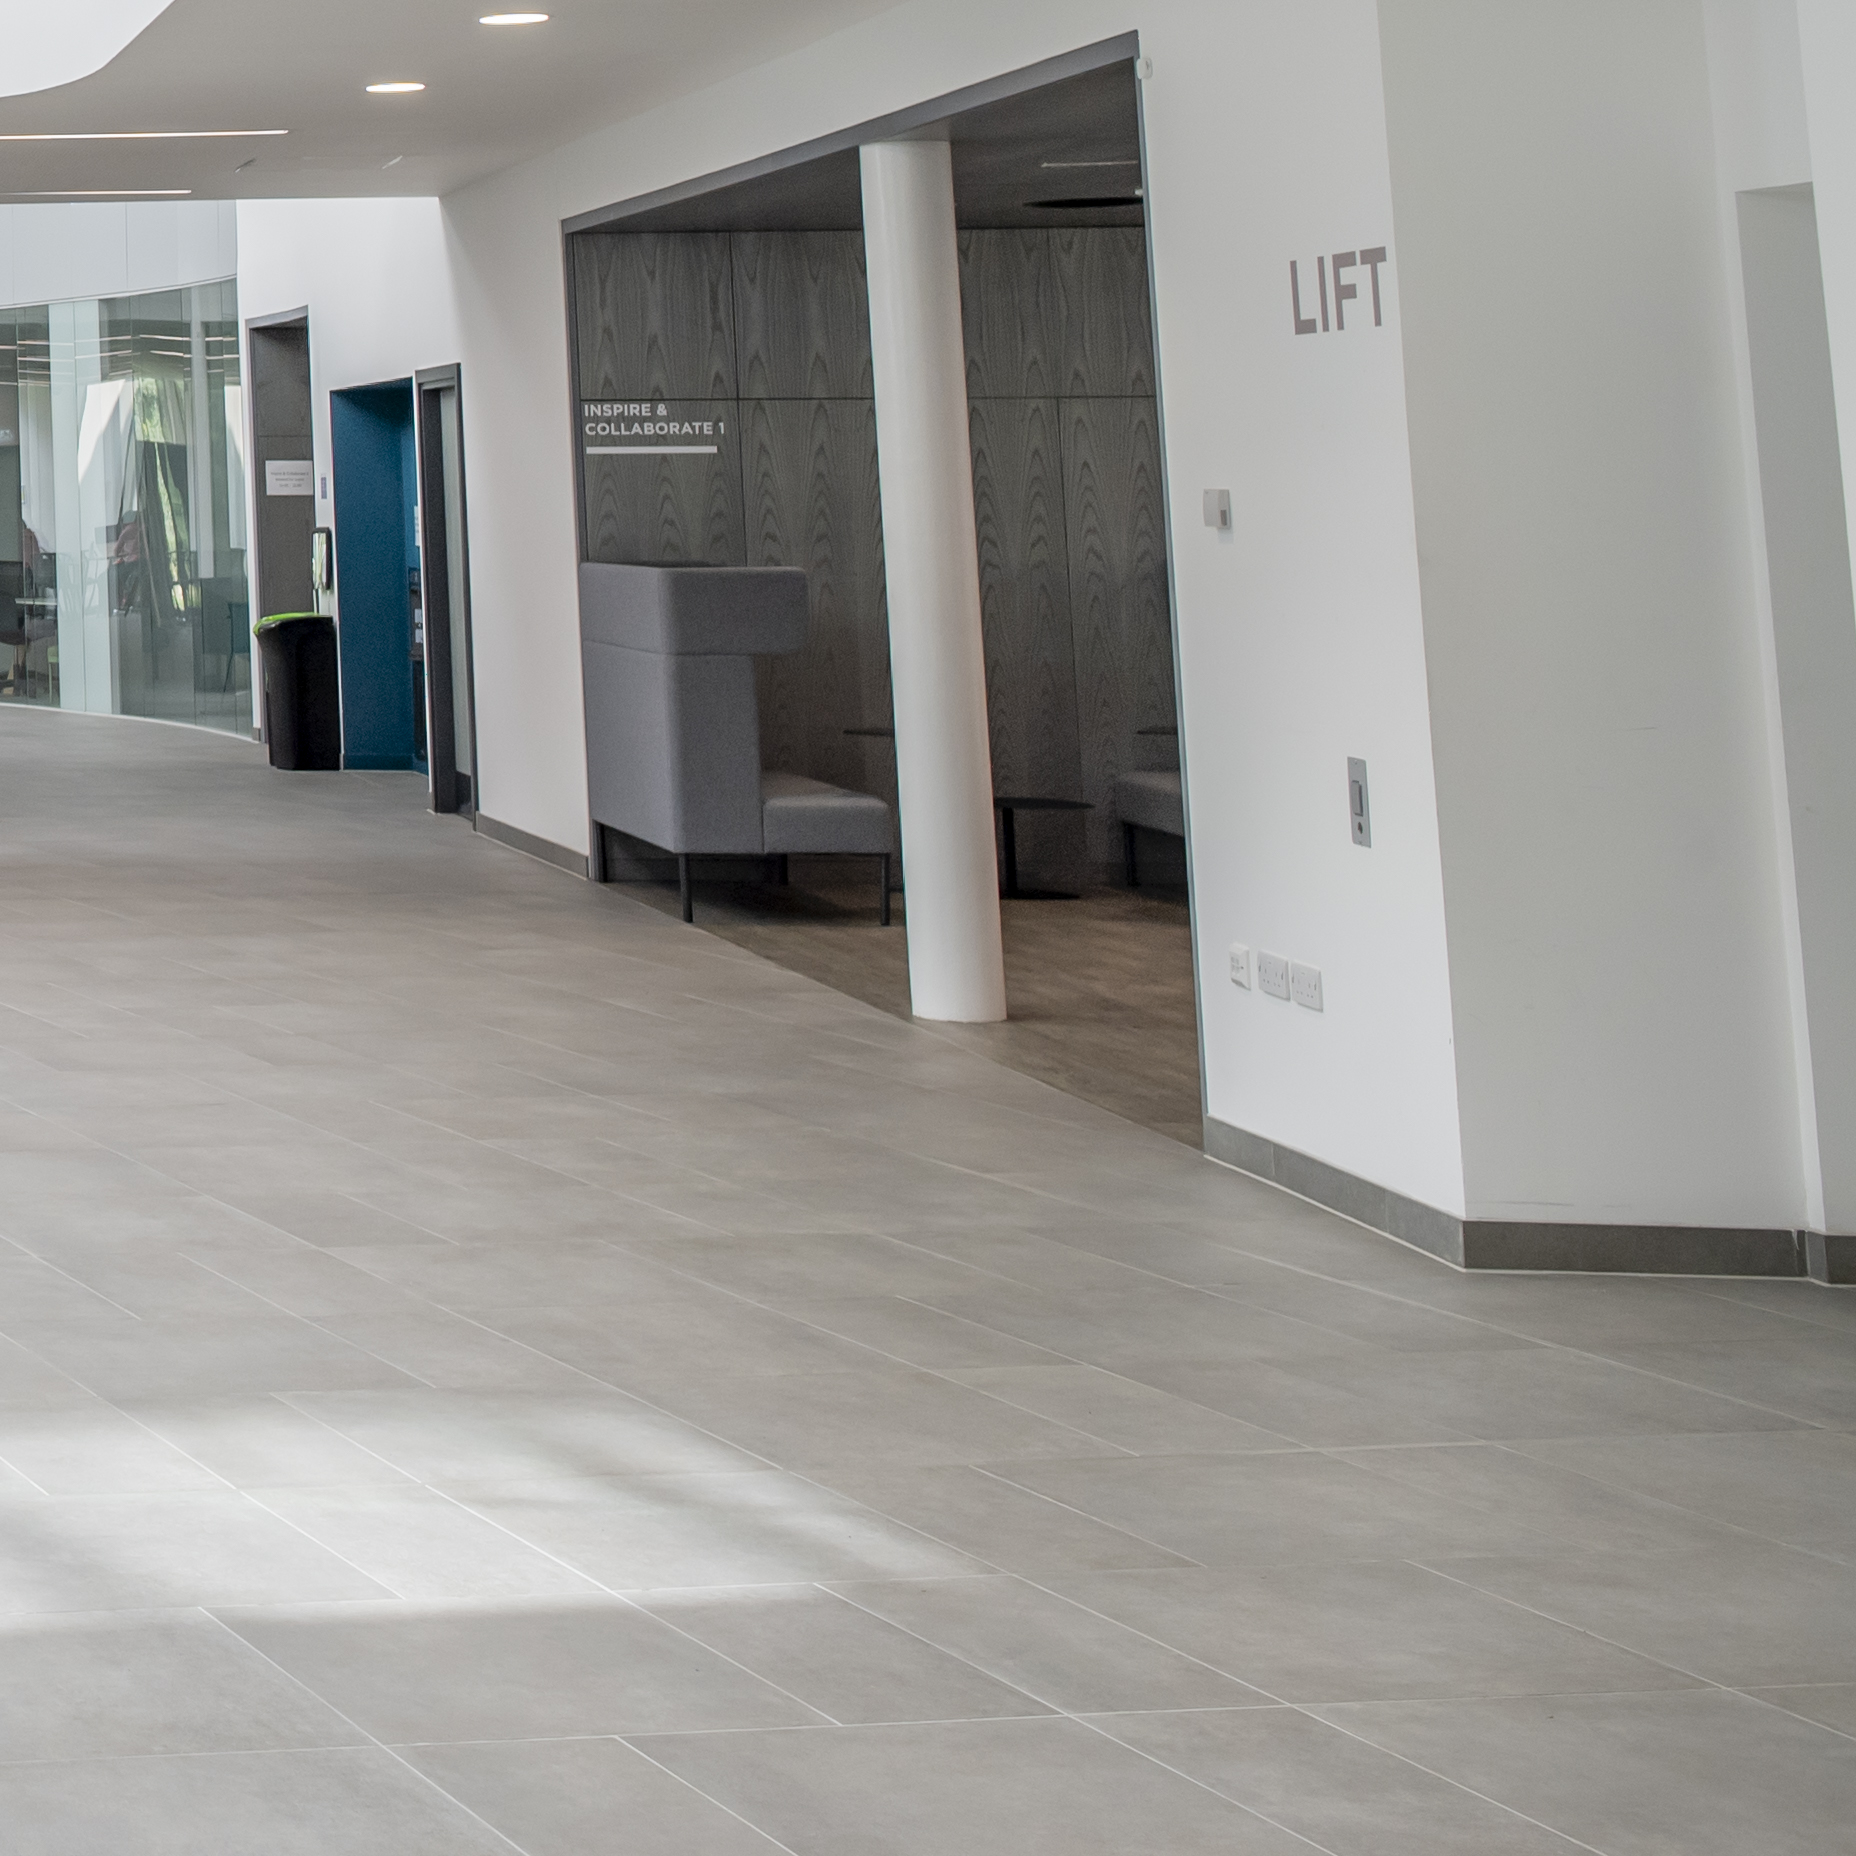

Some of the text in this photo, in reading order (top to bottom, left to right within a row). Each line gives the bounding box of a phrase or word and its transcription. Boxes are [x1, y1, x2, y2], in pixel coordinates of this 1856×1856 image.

[1290, 246, 1387, 336] LIFT
[584, 404, 668, 417] INSPIRE &
[585, 422, 724, 435] COLLABORATE 1
